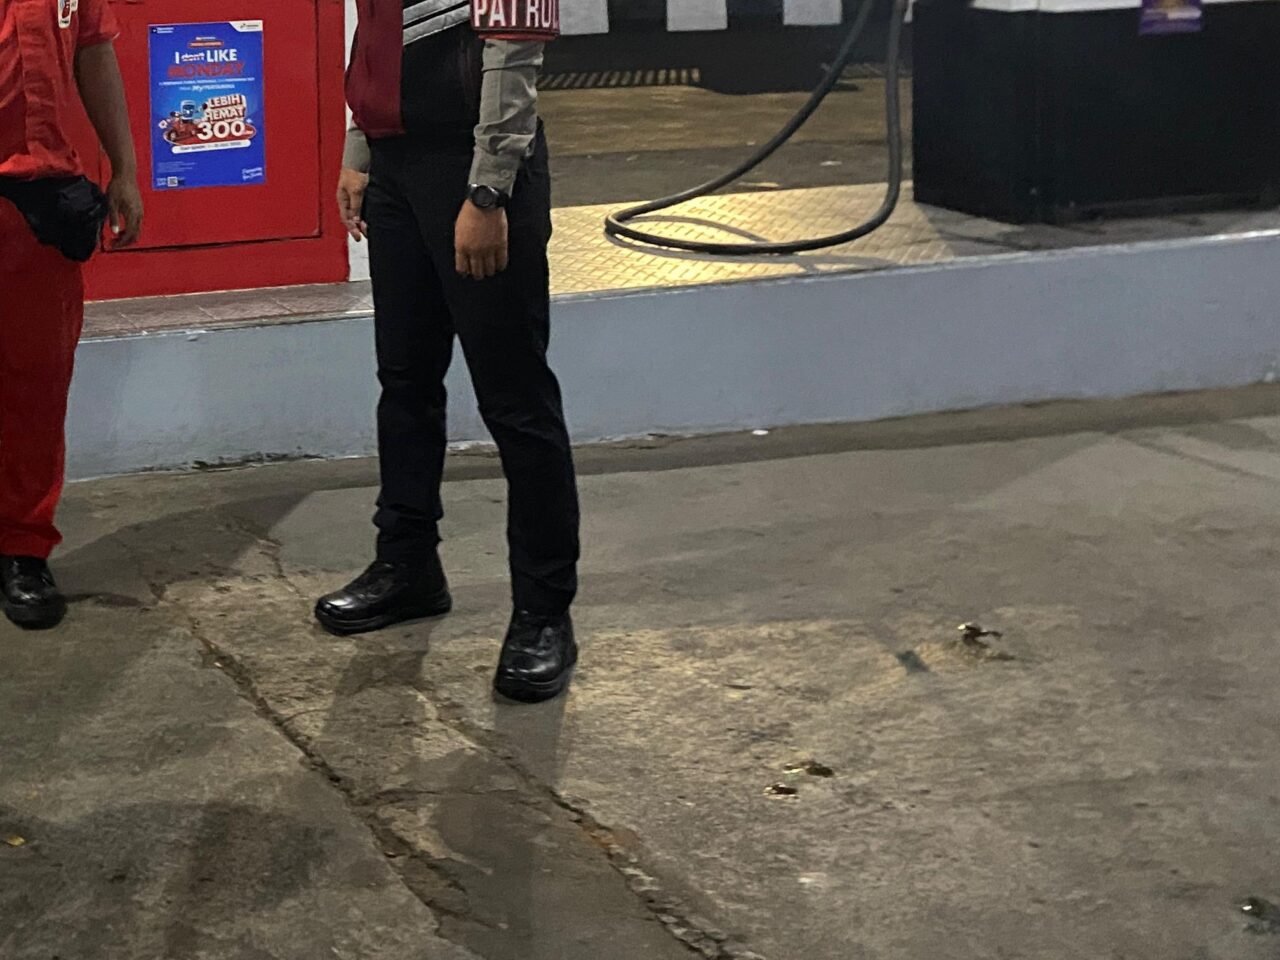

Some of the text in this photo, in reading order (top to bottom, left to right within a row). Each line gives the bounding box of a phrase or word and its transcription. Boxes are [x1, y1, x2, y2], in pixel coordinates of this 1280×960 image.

[207, 48, 238, 63] LIKE
[167, 62, 245, 78] MONDAY
[208, 94, 242, 108] LEBIH
[197, 120, 245, 140] 300
